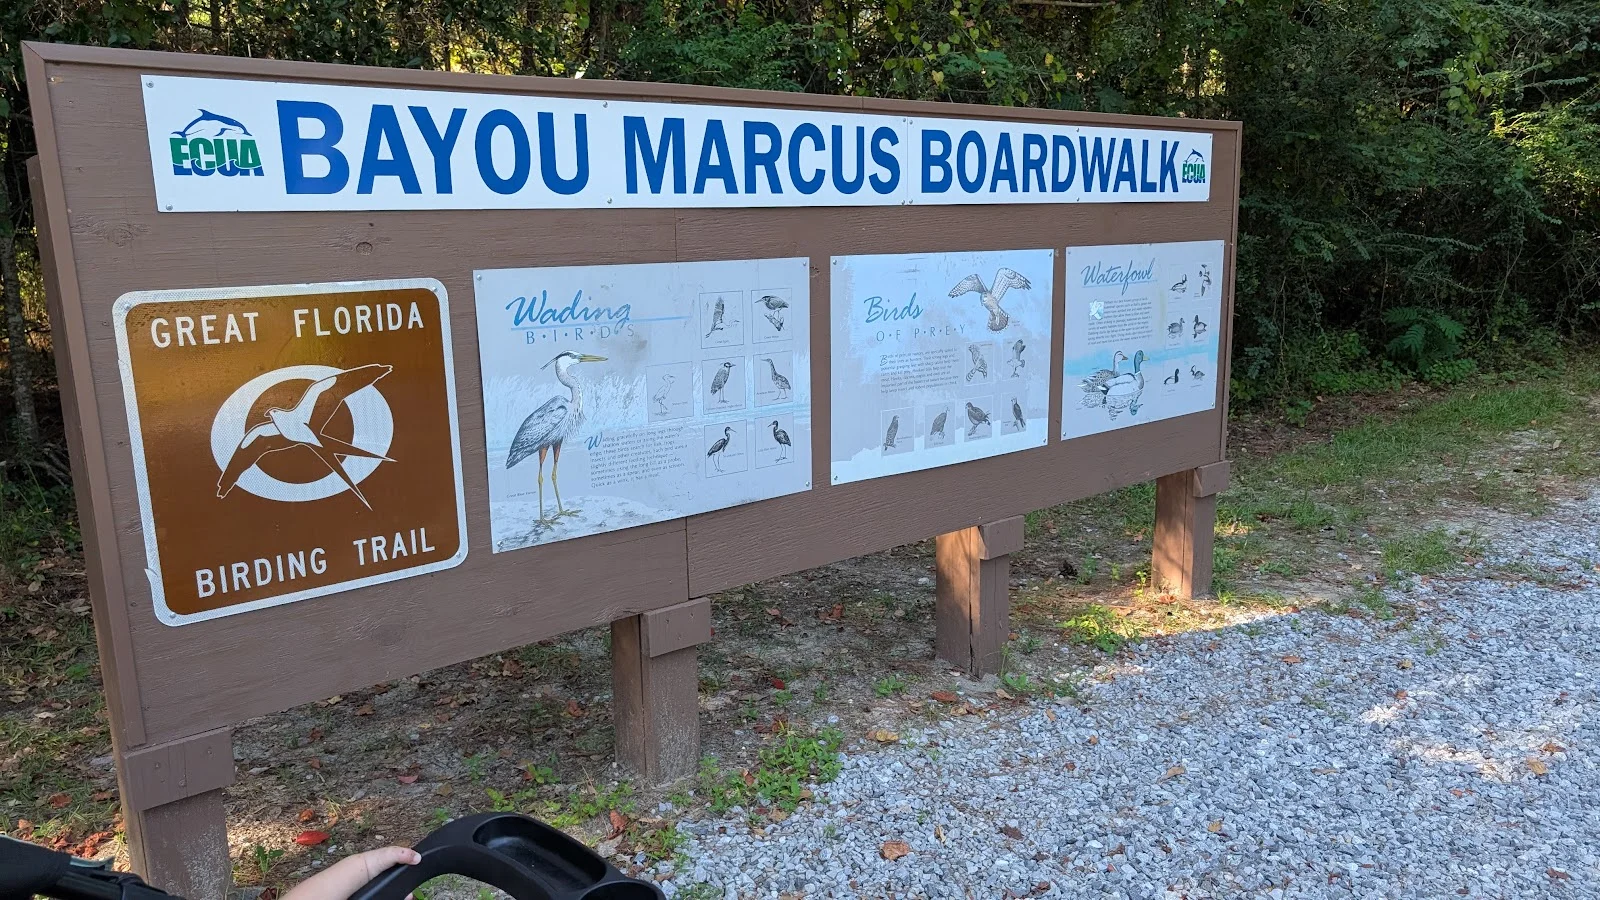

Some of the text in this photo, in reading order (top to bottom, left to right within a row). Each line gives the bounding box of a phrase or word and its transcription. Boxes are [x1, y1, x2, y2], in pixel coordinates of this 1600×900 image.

[169, 138, 264, 177] ECUA
[277, 100, 1179, 195] BAYOU MARCUS BOARDWALK
[1182, 163, 1206, 184] ECUA
[1081, 258, 1155, 296] Waterfowl
[150, 302, 424, 349] GREAT FLORIDA
[505, 289, 631, 333] Wading
[864, 292, 923, 324] Birds
[195, 527, 436, 598] BIRDING TRAIL
